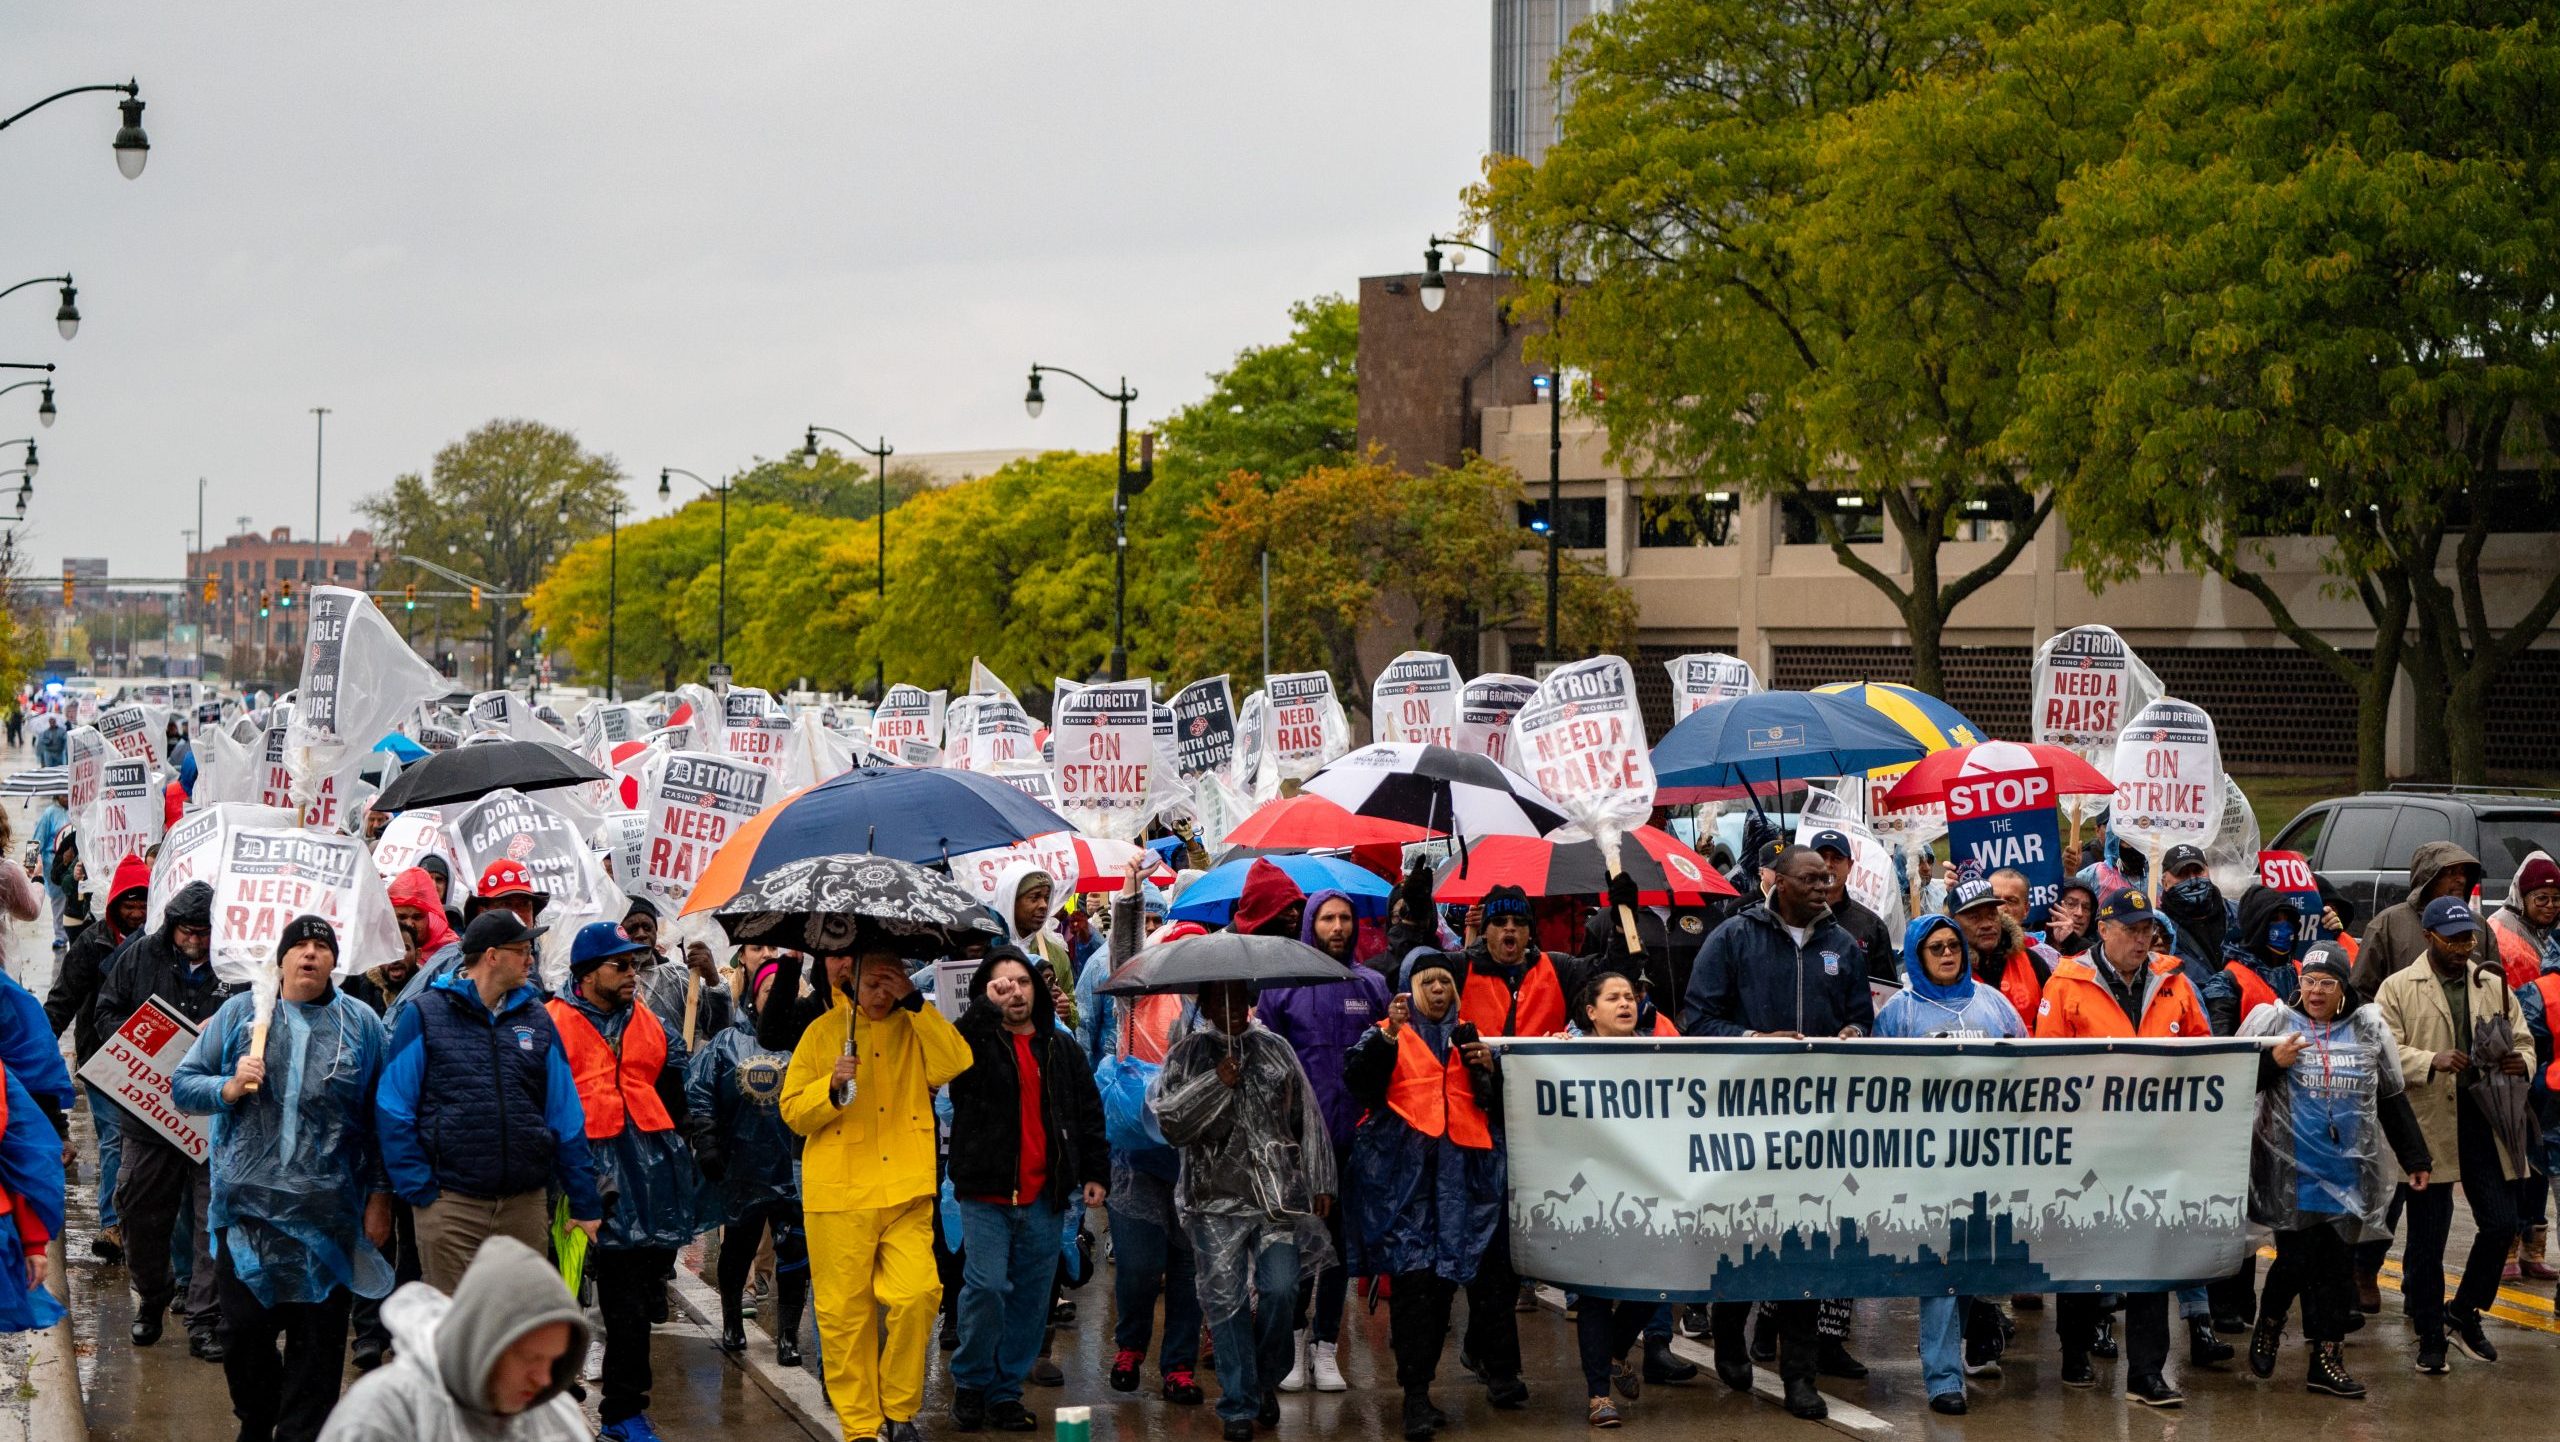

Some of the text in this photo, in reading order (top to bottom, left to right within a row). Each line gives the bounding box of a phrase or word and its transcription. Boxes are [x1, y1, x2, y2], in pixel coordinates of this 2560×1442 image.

[313, 675, 333, 691] OUR
[1691, 663, 1746, 684] DETROIT
[2055, 672, 2117, 697] NEED A
[1275, 678, 1325, 697] DETROIT
[1420, 684, 1449, 692] WORKERS
[1466, 690, 1488, 701] MGM
[1071, 693, 1138, 708] MOTORCITY
[1177, 697, 1224, 720] AMBLE
[1404, 699, 1430, 726] ON
[1581, 701, 1626, 713] WORKERS
[1248, 715, 1260, 732] BLE
[1280, 708, 1314, 727] NEED
[1466, 714, 1493, 722] CASINO
[2046, 698, 2119, 732] RAISE
[2145, 711, 2171, 721] GRAND
[2172, 711, 2204, 724] DETROIT
[139, 732, 147, 744] A
[879, 719, 925, 737] NEED A
[1207, 731, 1229, 746] OUR
[1278, 726, 1322, 751] RAIS
[1536, 717, 1624, 762] NEED A
[730, 731, 784, 752] NEED A
[993, 738, 1015, 761] ON
[1089, 732, 1121, 761] ON
[1179, 743, 1233, 770] FUTURE
[2146, 749, 2179, 779] ON
[107, 767, 139, 783] ORCITY
[322, 776, 333, 794] A
[669, 759, 762, 798] DETROIT
[1063, 764, 1147, 793] STRIKE
[1537, 749, 1643, 803] RAISE
[72, 780, 95, 805] RAIS
[117, 789, 145, 797] WORKERS
[665, 791, 696, 801] CASINO
[1950, 776, 2048, 816] STOP
[2117, 781, 2206, 815] STRIKE
[105, 804, 126, 831] ON
[484, 798, 535, 824] DON'T
[472, 814, 563, 854] GAMBLE
[664, 806, 725, 843] NEED
[1990, 819, 2012, 833] THE
[97, 832, 148, 861] TRIKE
[238, 834, 350, 873] DETROIT
[1971, 834, 2044, 870] WAR
[235, 866, 274, 874] CASINO
[534, 855, 573, 873] OUR
[2264, 860, 2314, 889] STOP
[238, 879, 311, 907] NEED
[2290, 897, 2305, 910] THE
[2299, 914, 2320, 941] AR
[2303, 1052, 2356, 1067] DEROIT
[106, 1042, 178, 1105] gether
[750, 1071, 774, 1083] UAW
[1535, 1074, 2225, 1119] DETROIT'S MARCH FOR WORKERS' RIGHTS
[118, 1082, 208, 1156] Stronger
[1688, 1126, 2073, 1172] AND ECONOMIC JUSTICE
